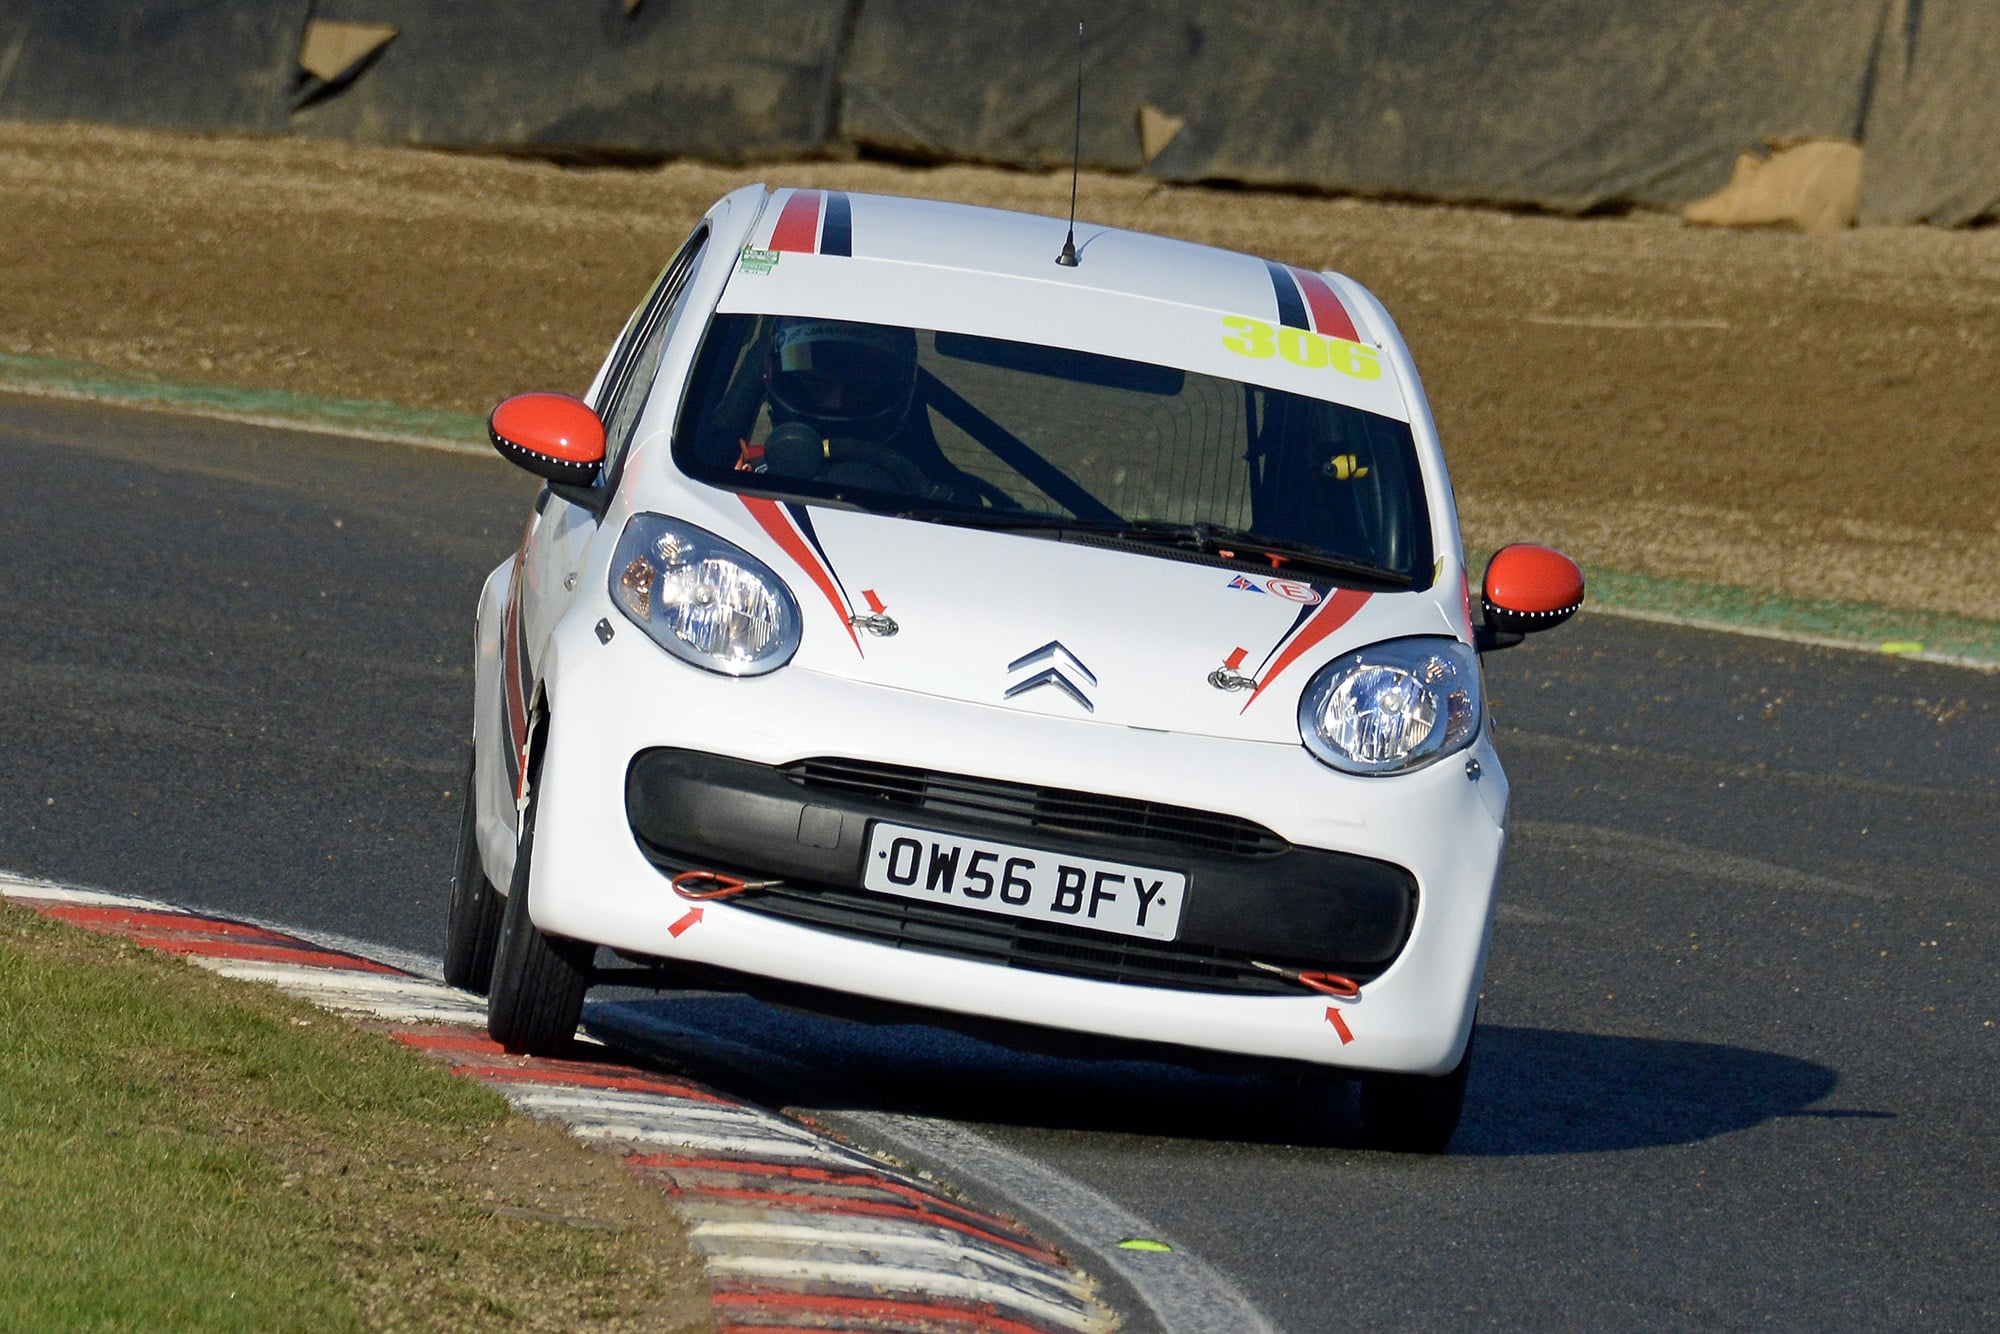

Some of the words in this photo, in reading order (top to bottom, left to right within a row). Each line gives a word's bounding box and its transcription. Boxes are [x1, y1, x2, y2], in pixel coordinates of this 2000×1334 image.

[1222, 315, 1381, 380] 306
[1281, 584, 1307, 599] E
[886, 837, 1036, 906] OW56
[1050, 865, 1163, 927] BFY
